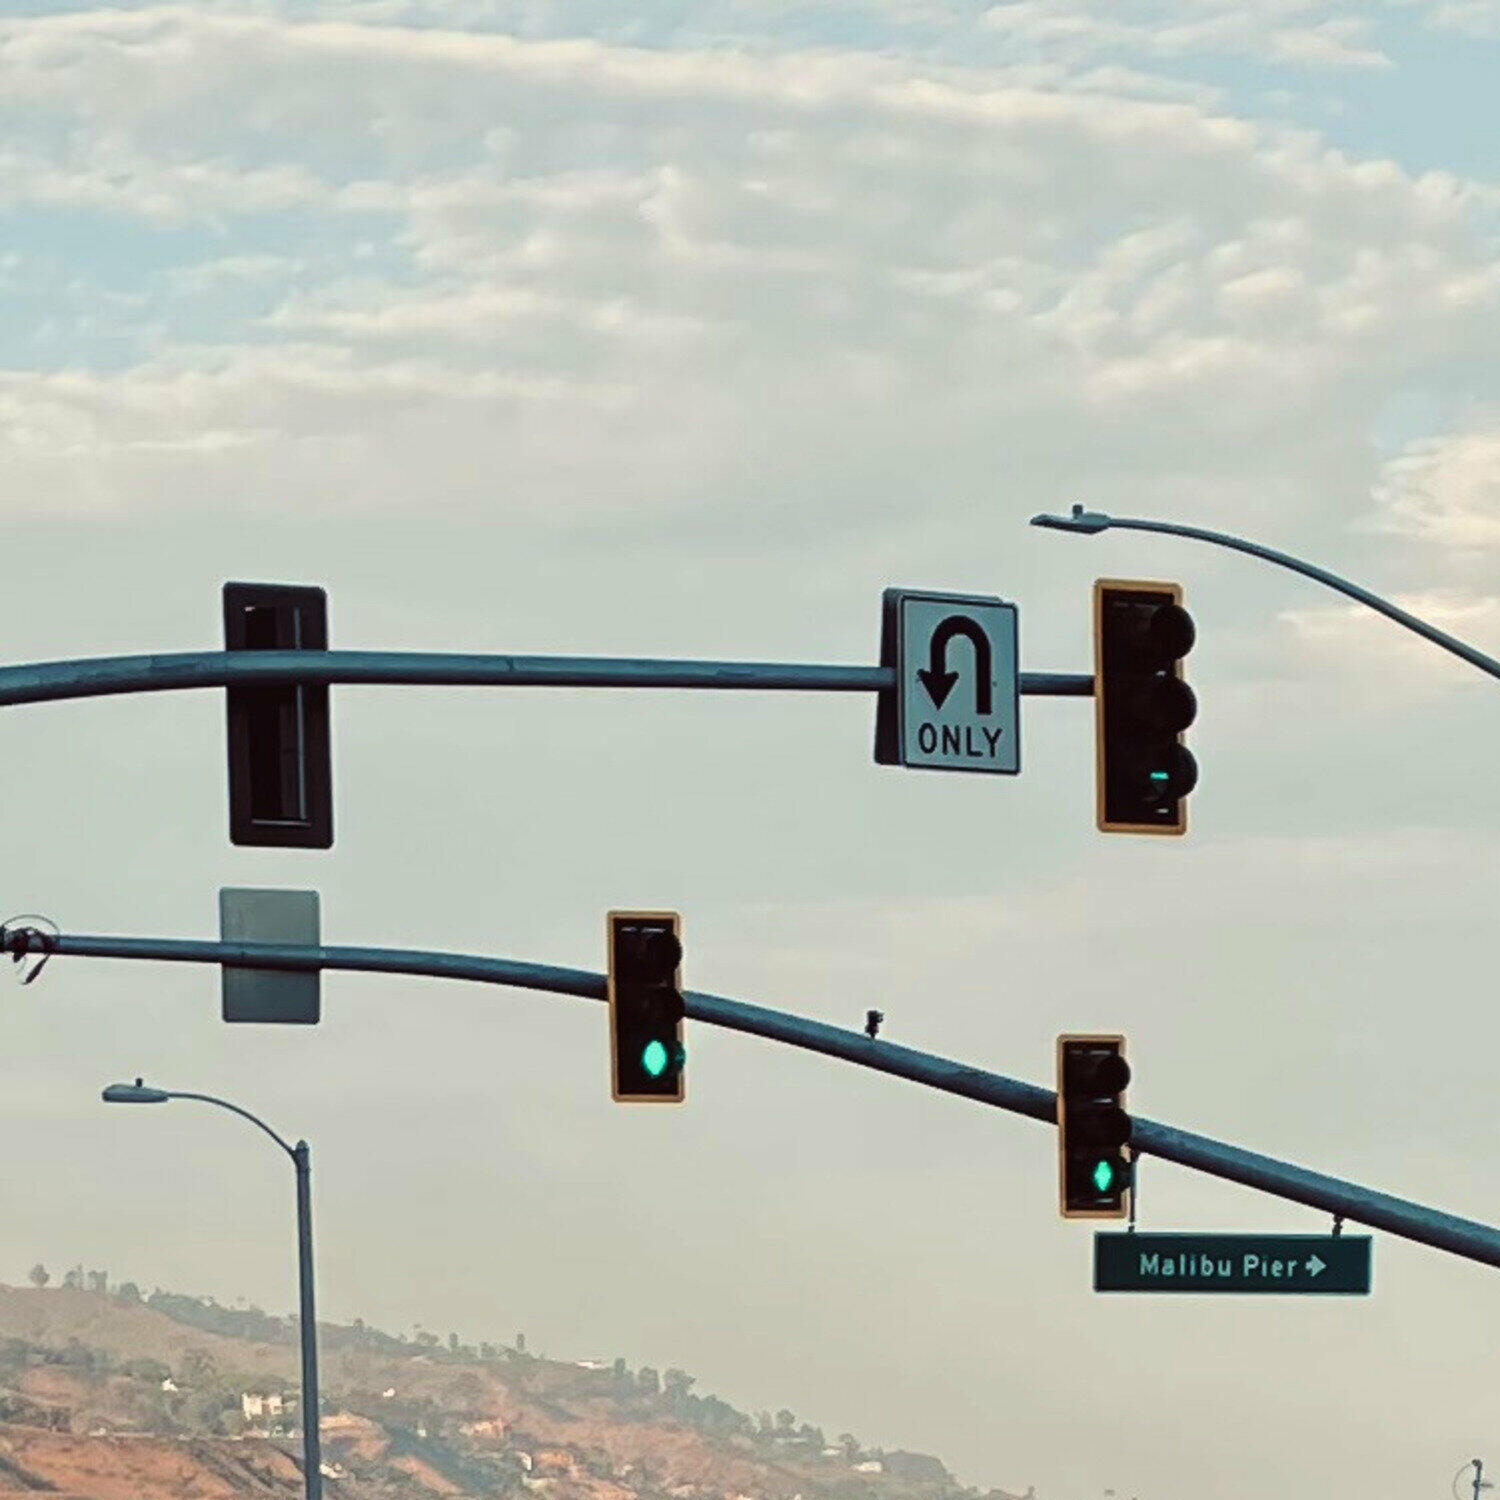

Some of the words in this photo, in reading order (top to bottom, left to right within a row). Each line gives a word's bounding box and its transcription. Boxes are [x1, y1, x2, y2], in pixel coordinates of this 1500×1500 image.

[918, 722, 1003, 758] ONLY
[1139, 1254, 1232, 1277] Malibu
[1243, 1254, 1297, 1277] Pier
